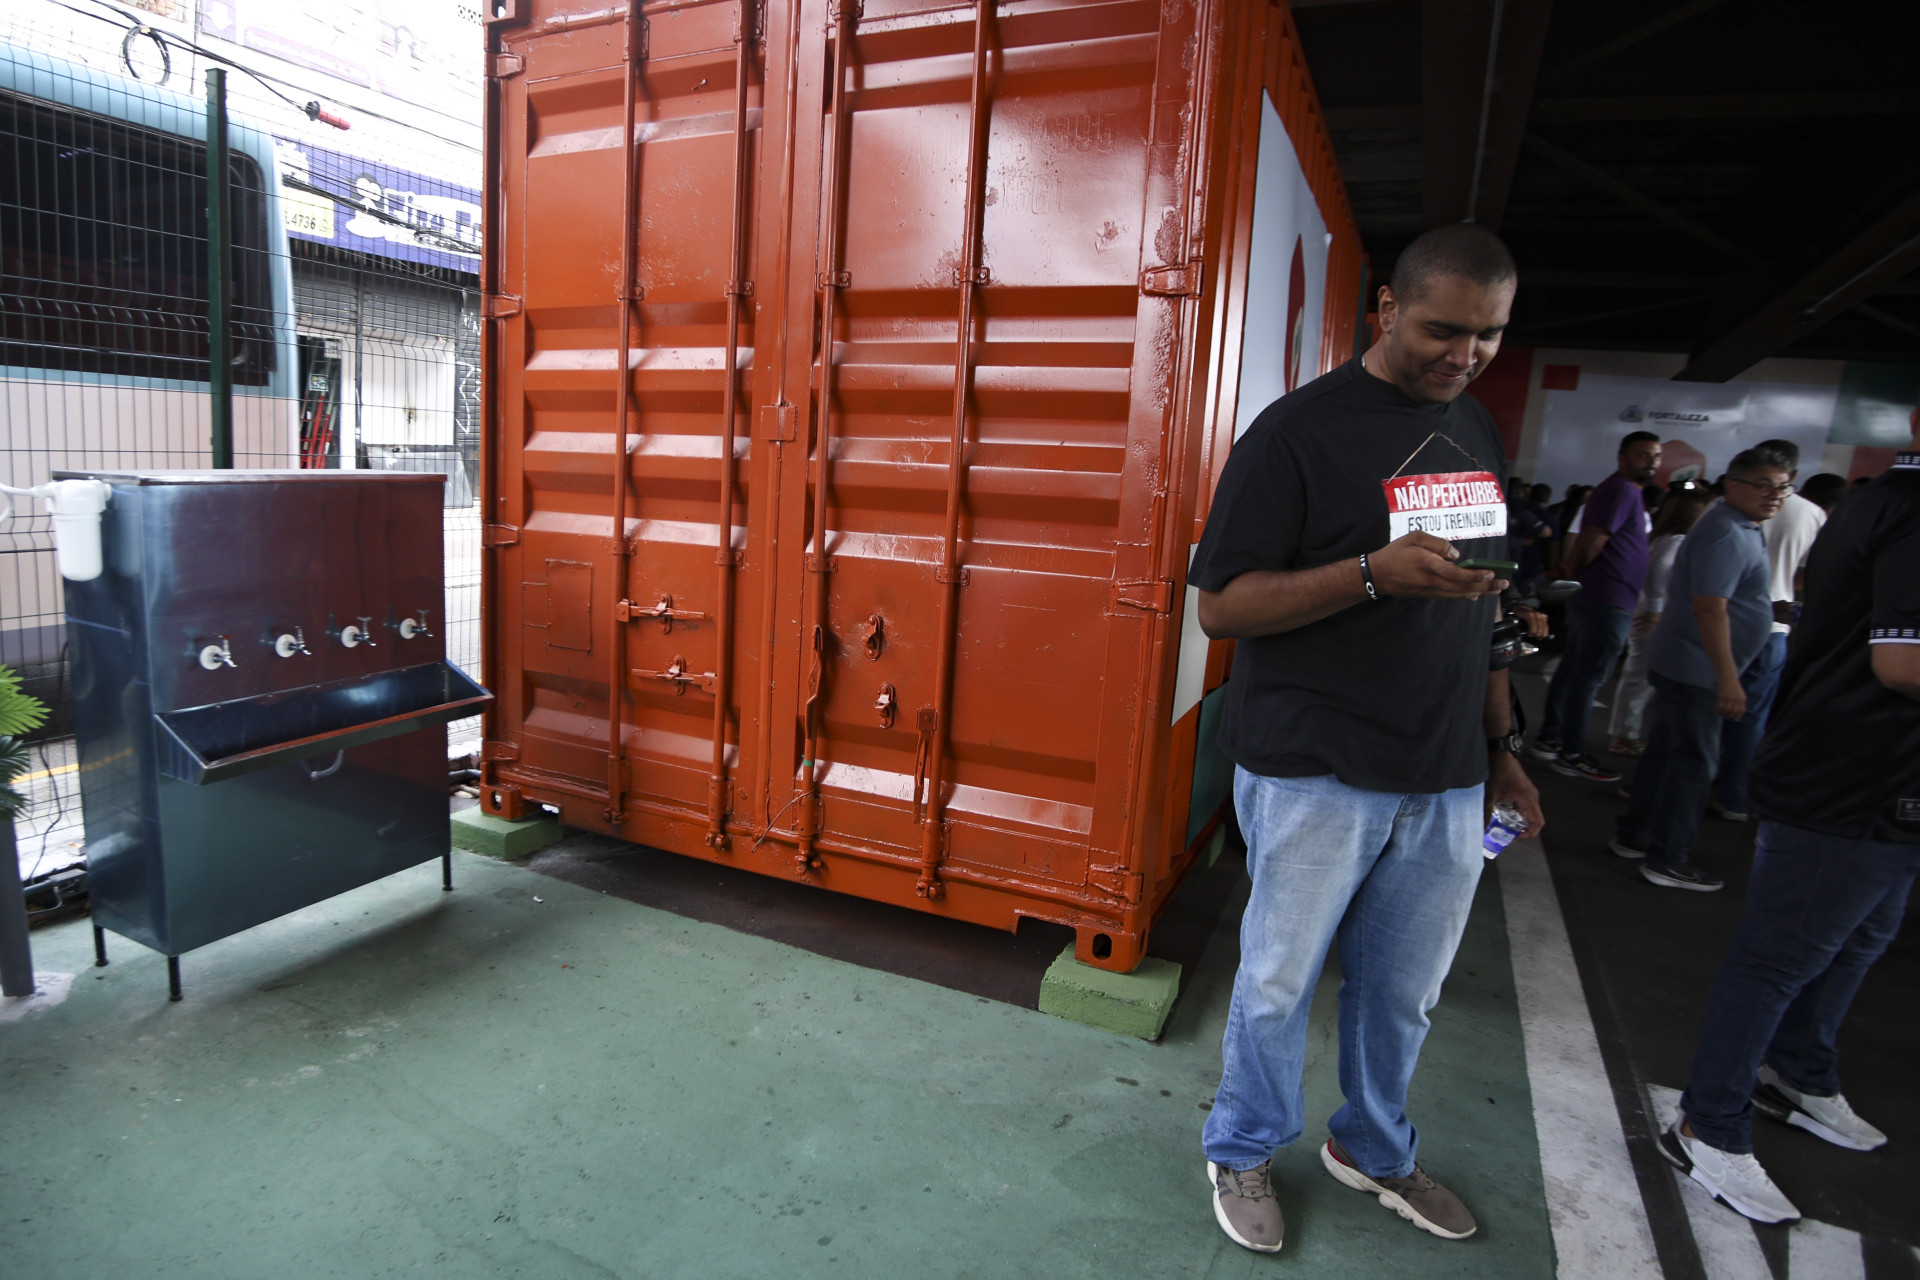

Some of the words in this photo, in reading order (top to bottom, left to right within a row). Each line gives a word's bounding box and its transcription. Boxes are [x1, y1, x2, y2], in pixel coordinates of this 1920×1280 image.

[1648, 411, 1710, 422] FORTALEZA
[1394, 481, 1429, 510] NÃO
[1432, 481, 1501, 507] PERTURBE
[1408, 514, 1441, 532] ESTOU
